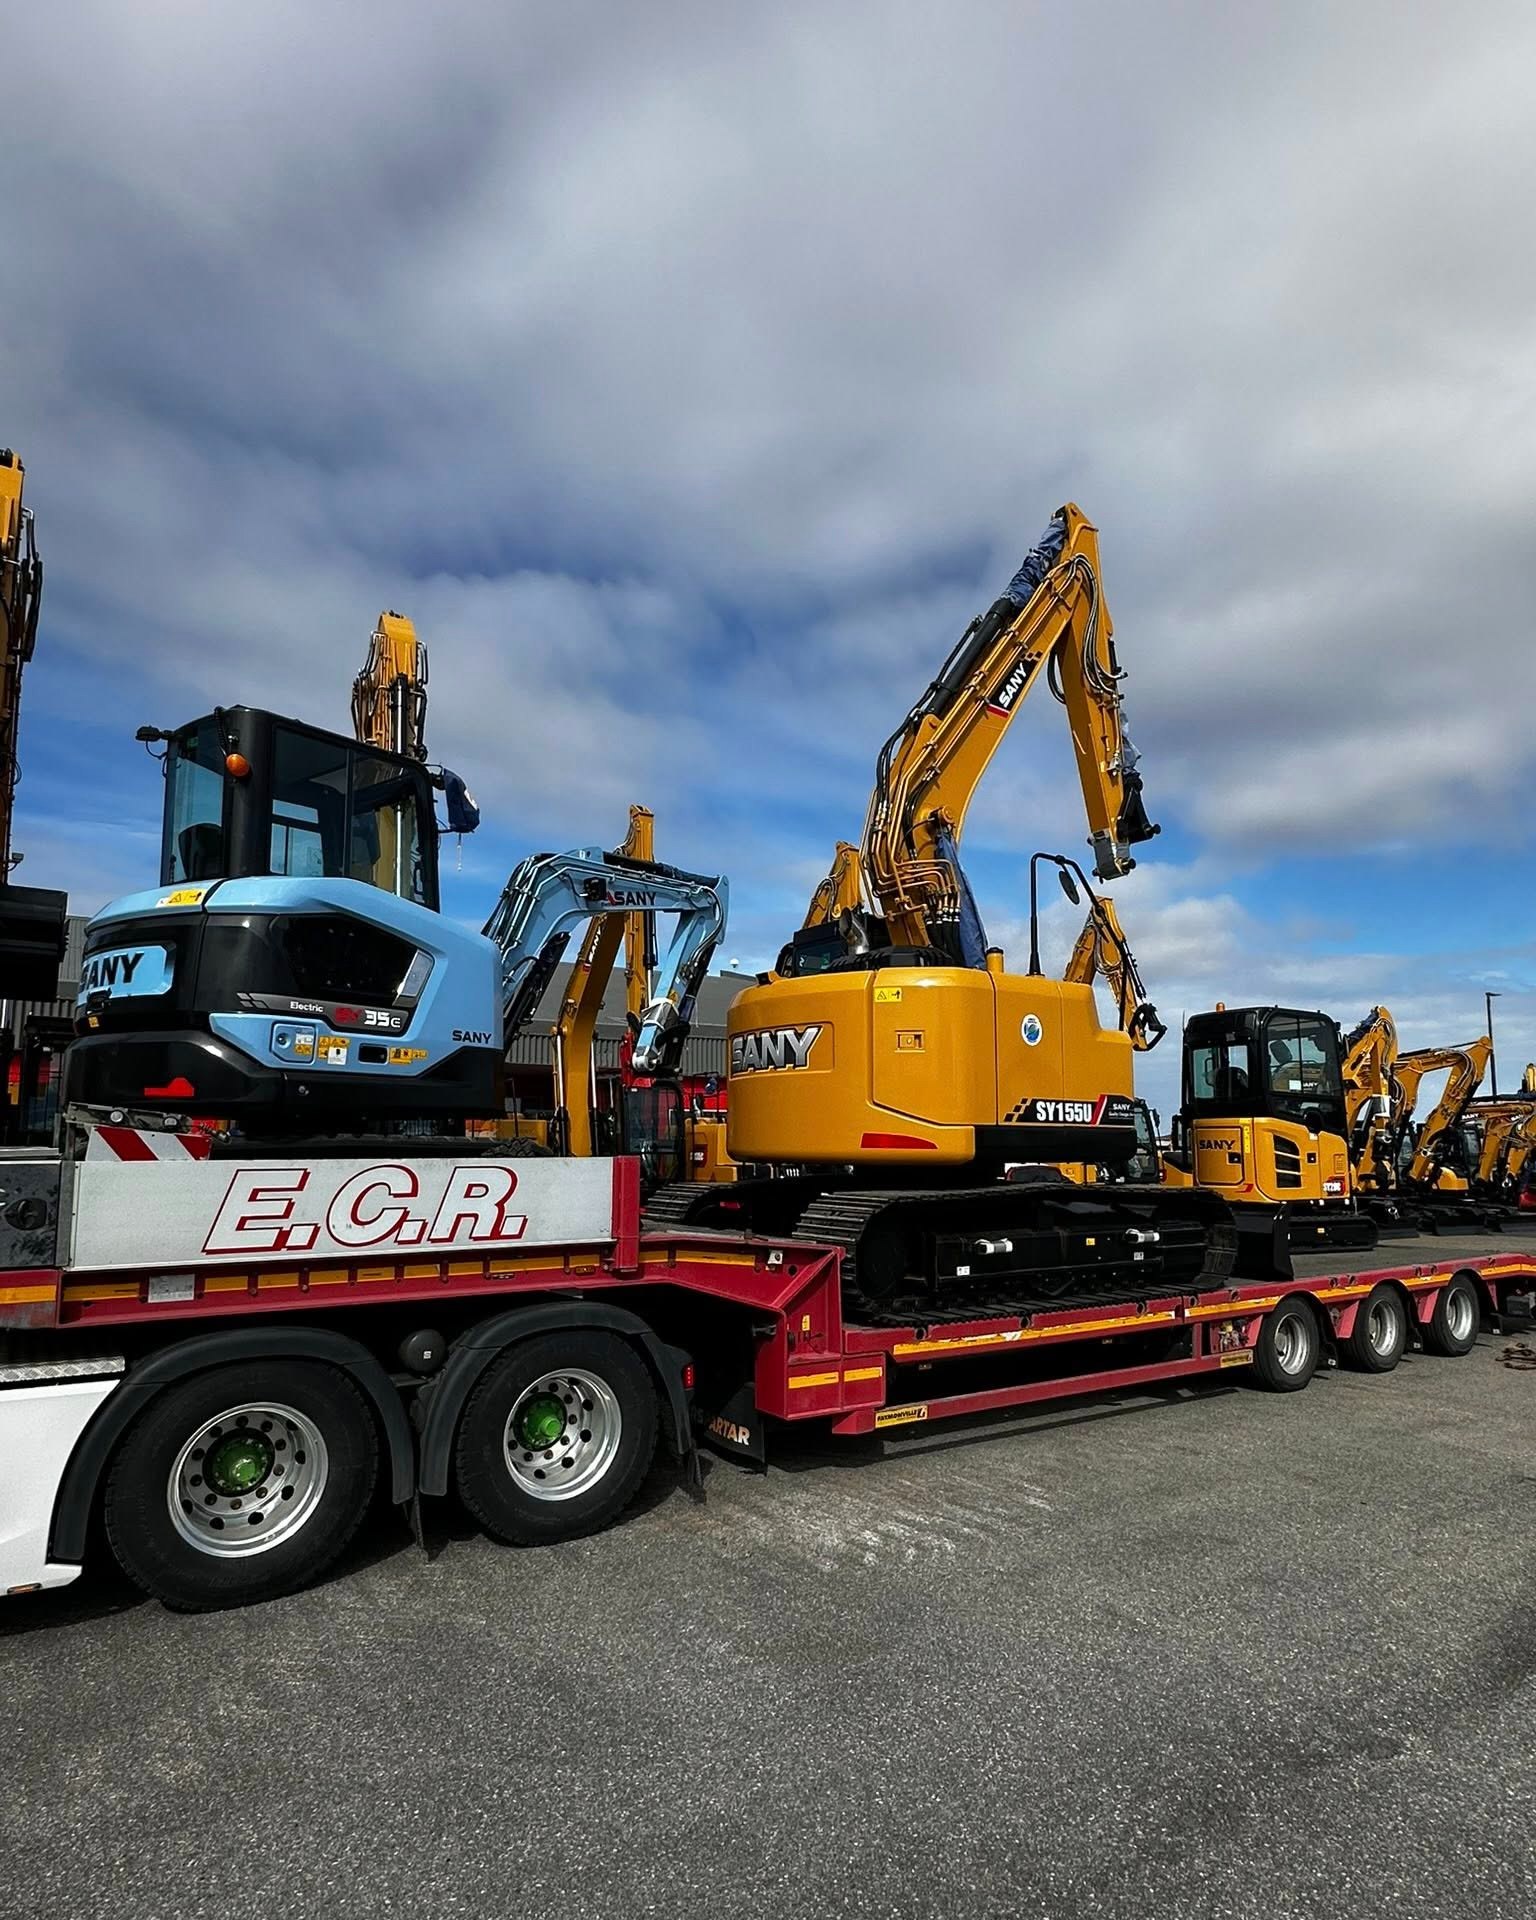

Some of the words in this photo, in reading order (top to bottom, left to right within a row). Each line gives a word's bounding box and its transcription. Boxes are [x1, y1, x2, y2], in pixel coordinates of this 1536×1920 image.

[999, 662, 1027, 708] SANY
[614, 891, 656, 906] SANY
[290, 1001, 324, 1013] Electric
[452, 1030, 492, 1045] SANY
[732, 1027, 822, 1075] SANY
[1036, 1100, 1093, 1123] SY155U
[1112, 1103, 1131, 1111] SANY
[1200, 1139, 1235, 1150] SANY
[202, 1164, 528, 1255] E.C.R.
